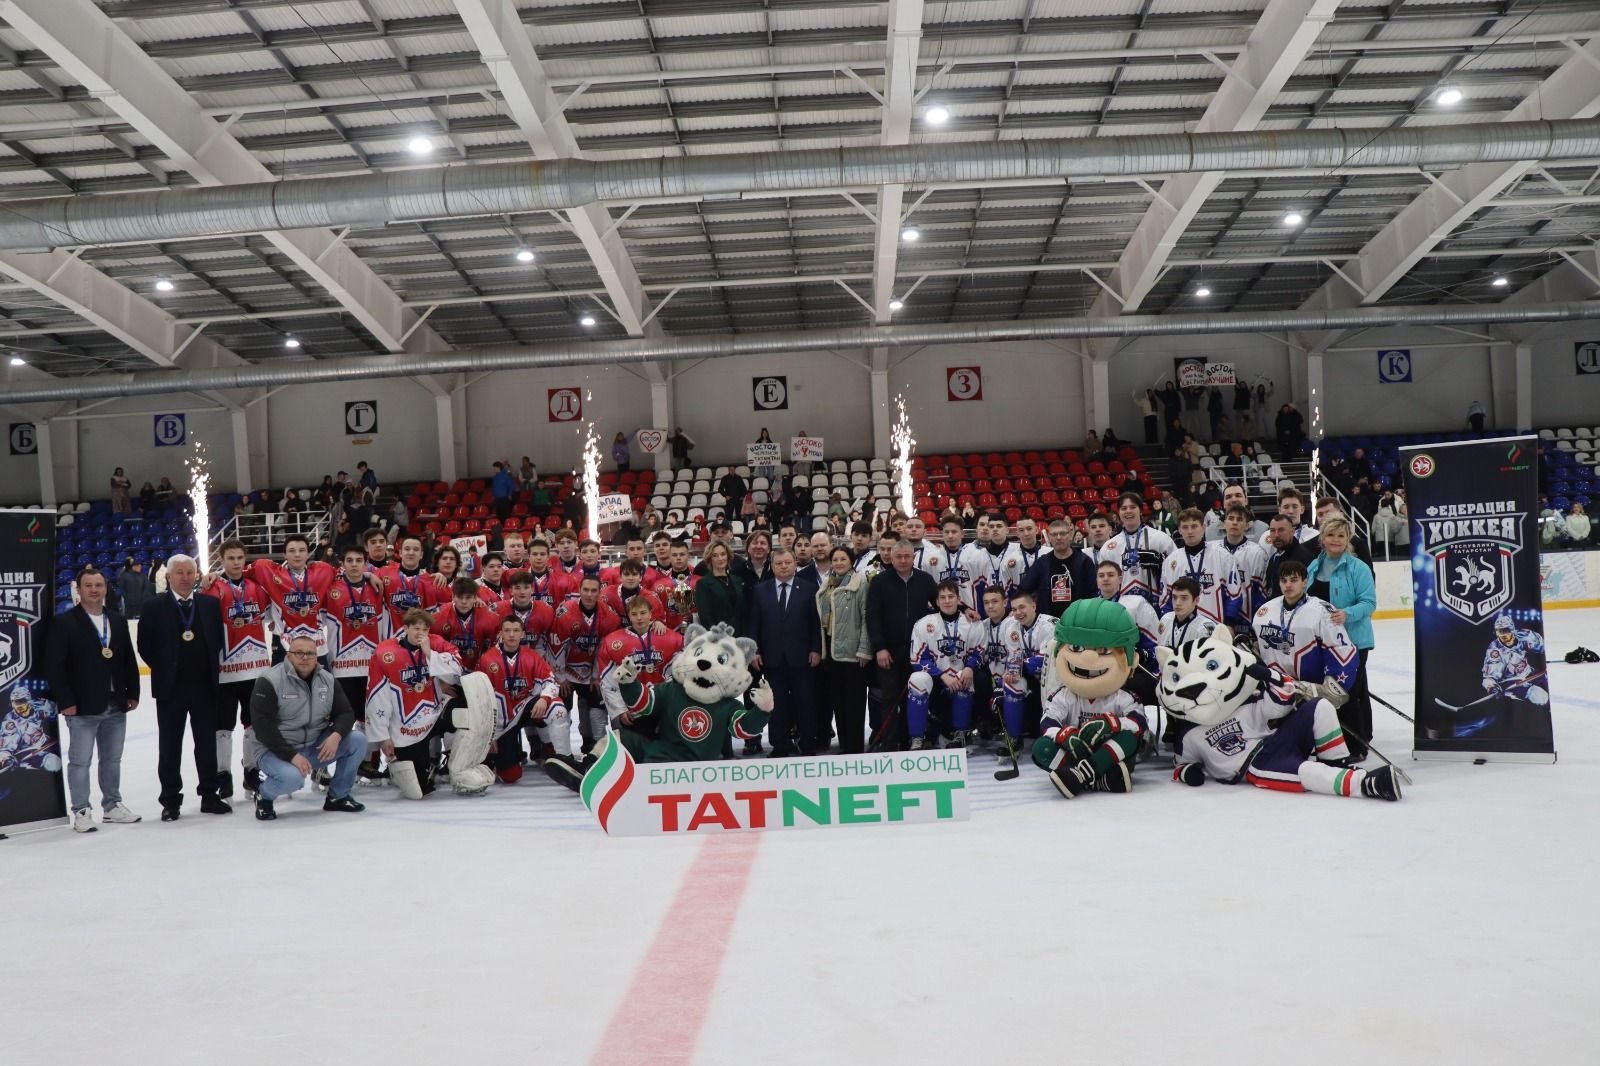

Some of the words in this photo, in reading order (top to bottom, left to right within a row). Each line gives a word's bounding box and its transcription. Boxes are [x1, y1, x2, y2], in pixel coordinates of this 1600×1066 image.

[1207, 363, 1233, 376] ВОСТОК
[1389, 356, 1405, 375] К
[763, 383, 778, 403] Е
[556, 395, 573, 416] Д
[354, 408, 369, 427] Г
[18, 429, 33, 448] Б
[161, 420, 177, 439] В
[750, 444, 777, 452] ВОСТОК
[1426, 501, 1516, 517] ФЕДЕРАЦИЯ
[1429, 517, 1516, 545] ХОККЕЯ
[0, 588, 34, 611] ЕЯ
[1336, 633, 1348, 647] 2
[650, 755, 893, 785] БЛАГОТВОРИТЕЛЬНЫЙ
[900, 754, 962, 773] ФОНД
[648, 780, 965, 832] TATNEFT
